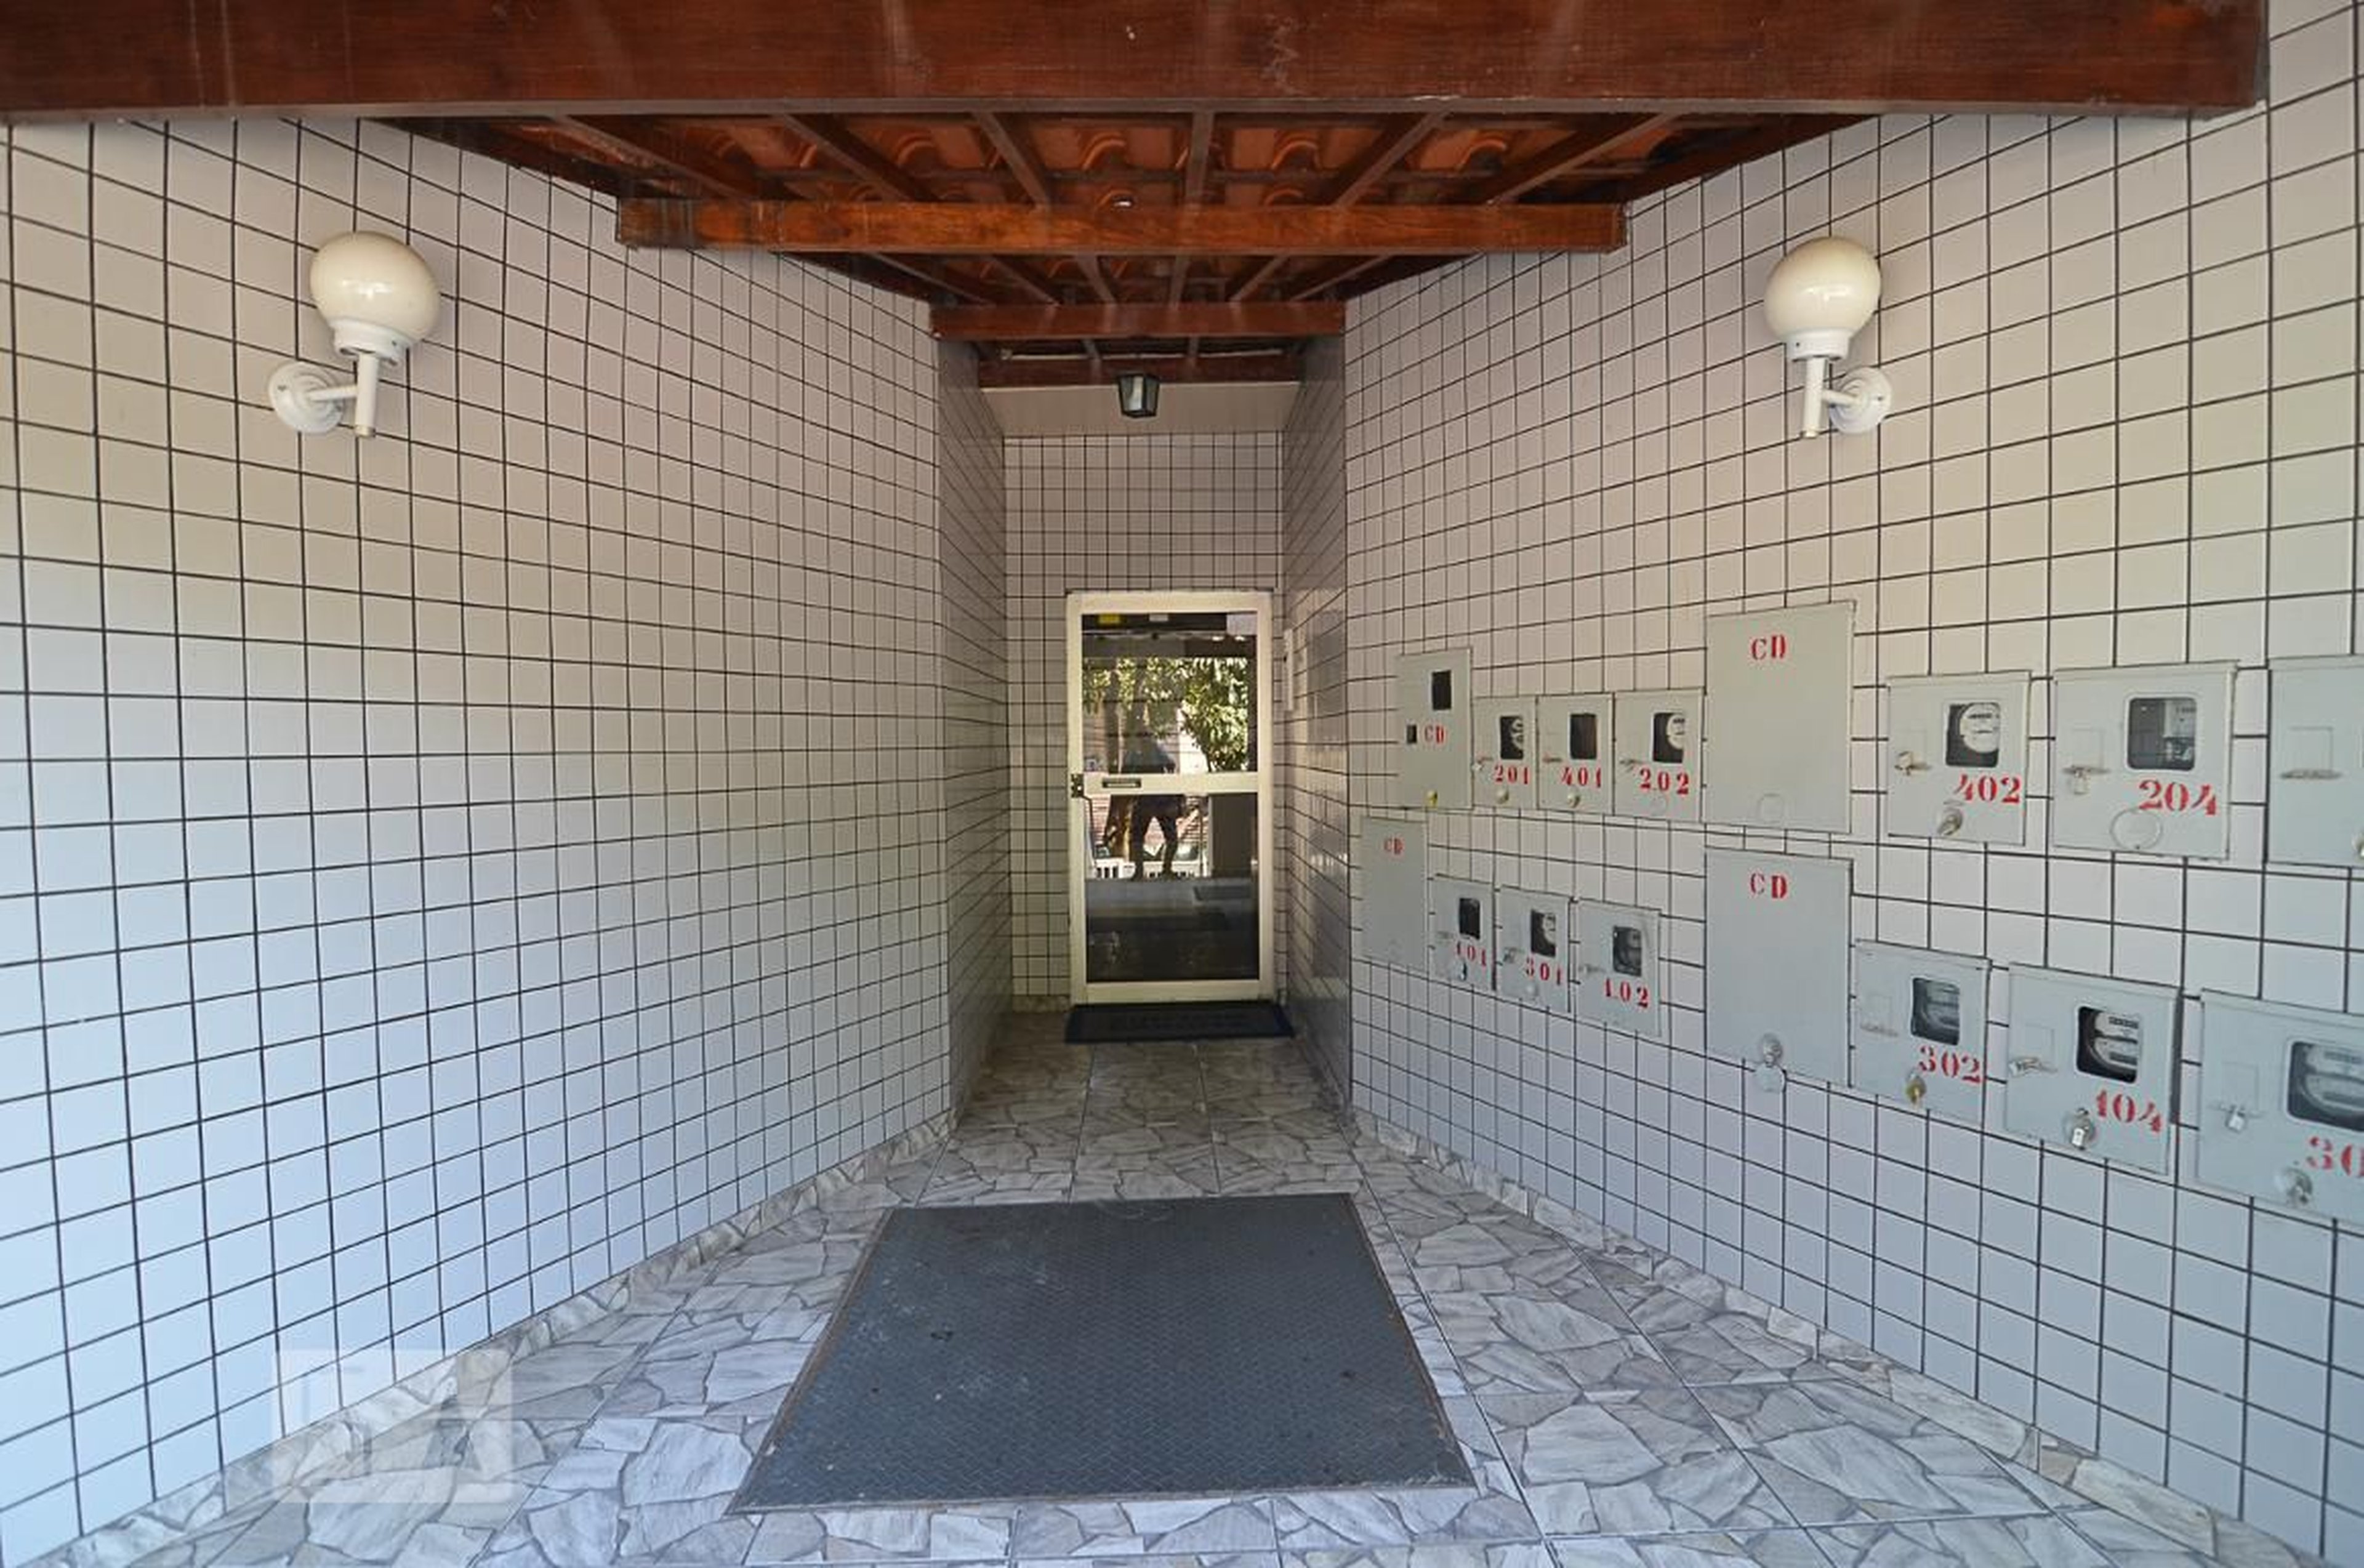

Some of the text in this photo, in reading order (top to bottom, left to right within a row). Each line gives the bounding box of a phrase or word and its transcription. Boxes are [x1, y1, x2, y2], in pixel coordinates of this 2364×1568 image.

[1749, 633, 1788, 661] CD
[1424, 724, 1446, 744] CD
[1494, 764, 1531, 785] 201
[1560, 765, 1602, 788] 401
[1639, 766, 1691, 795] 202
[1953, 773, 2022, 804] 402
[2137, 779, 2218, 816] 204
[1383, 837, 1405, 855] CD
[1749, 872, 1788, 899] CD
[1455, 943, 1487, 967] 101
[1524, 957, 1564, 986] 301
[1604, 981, 1650, 1009] 102
[1918, 1044, 1982, 1084] 302
[2095, 1088, 2163, 1133] 104
